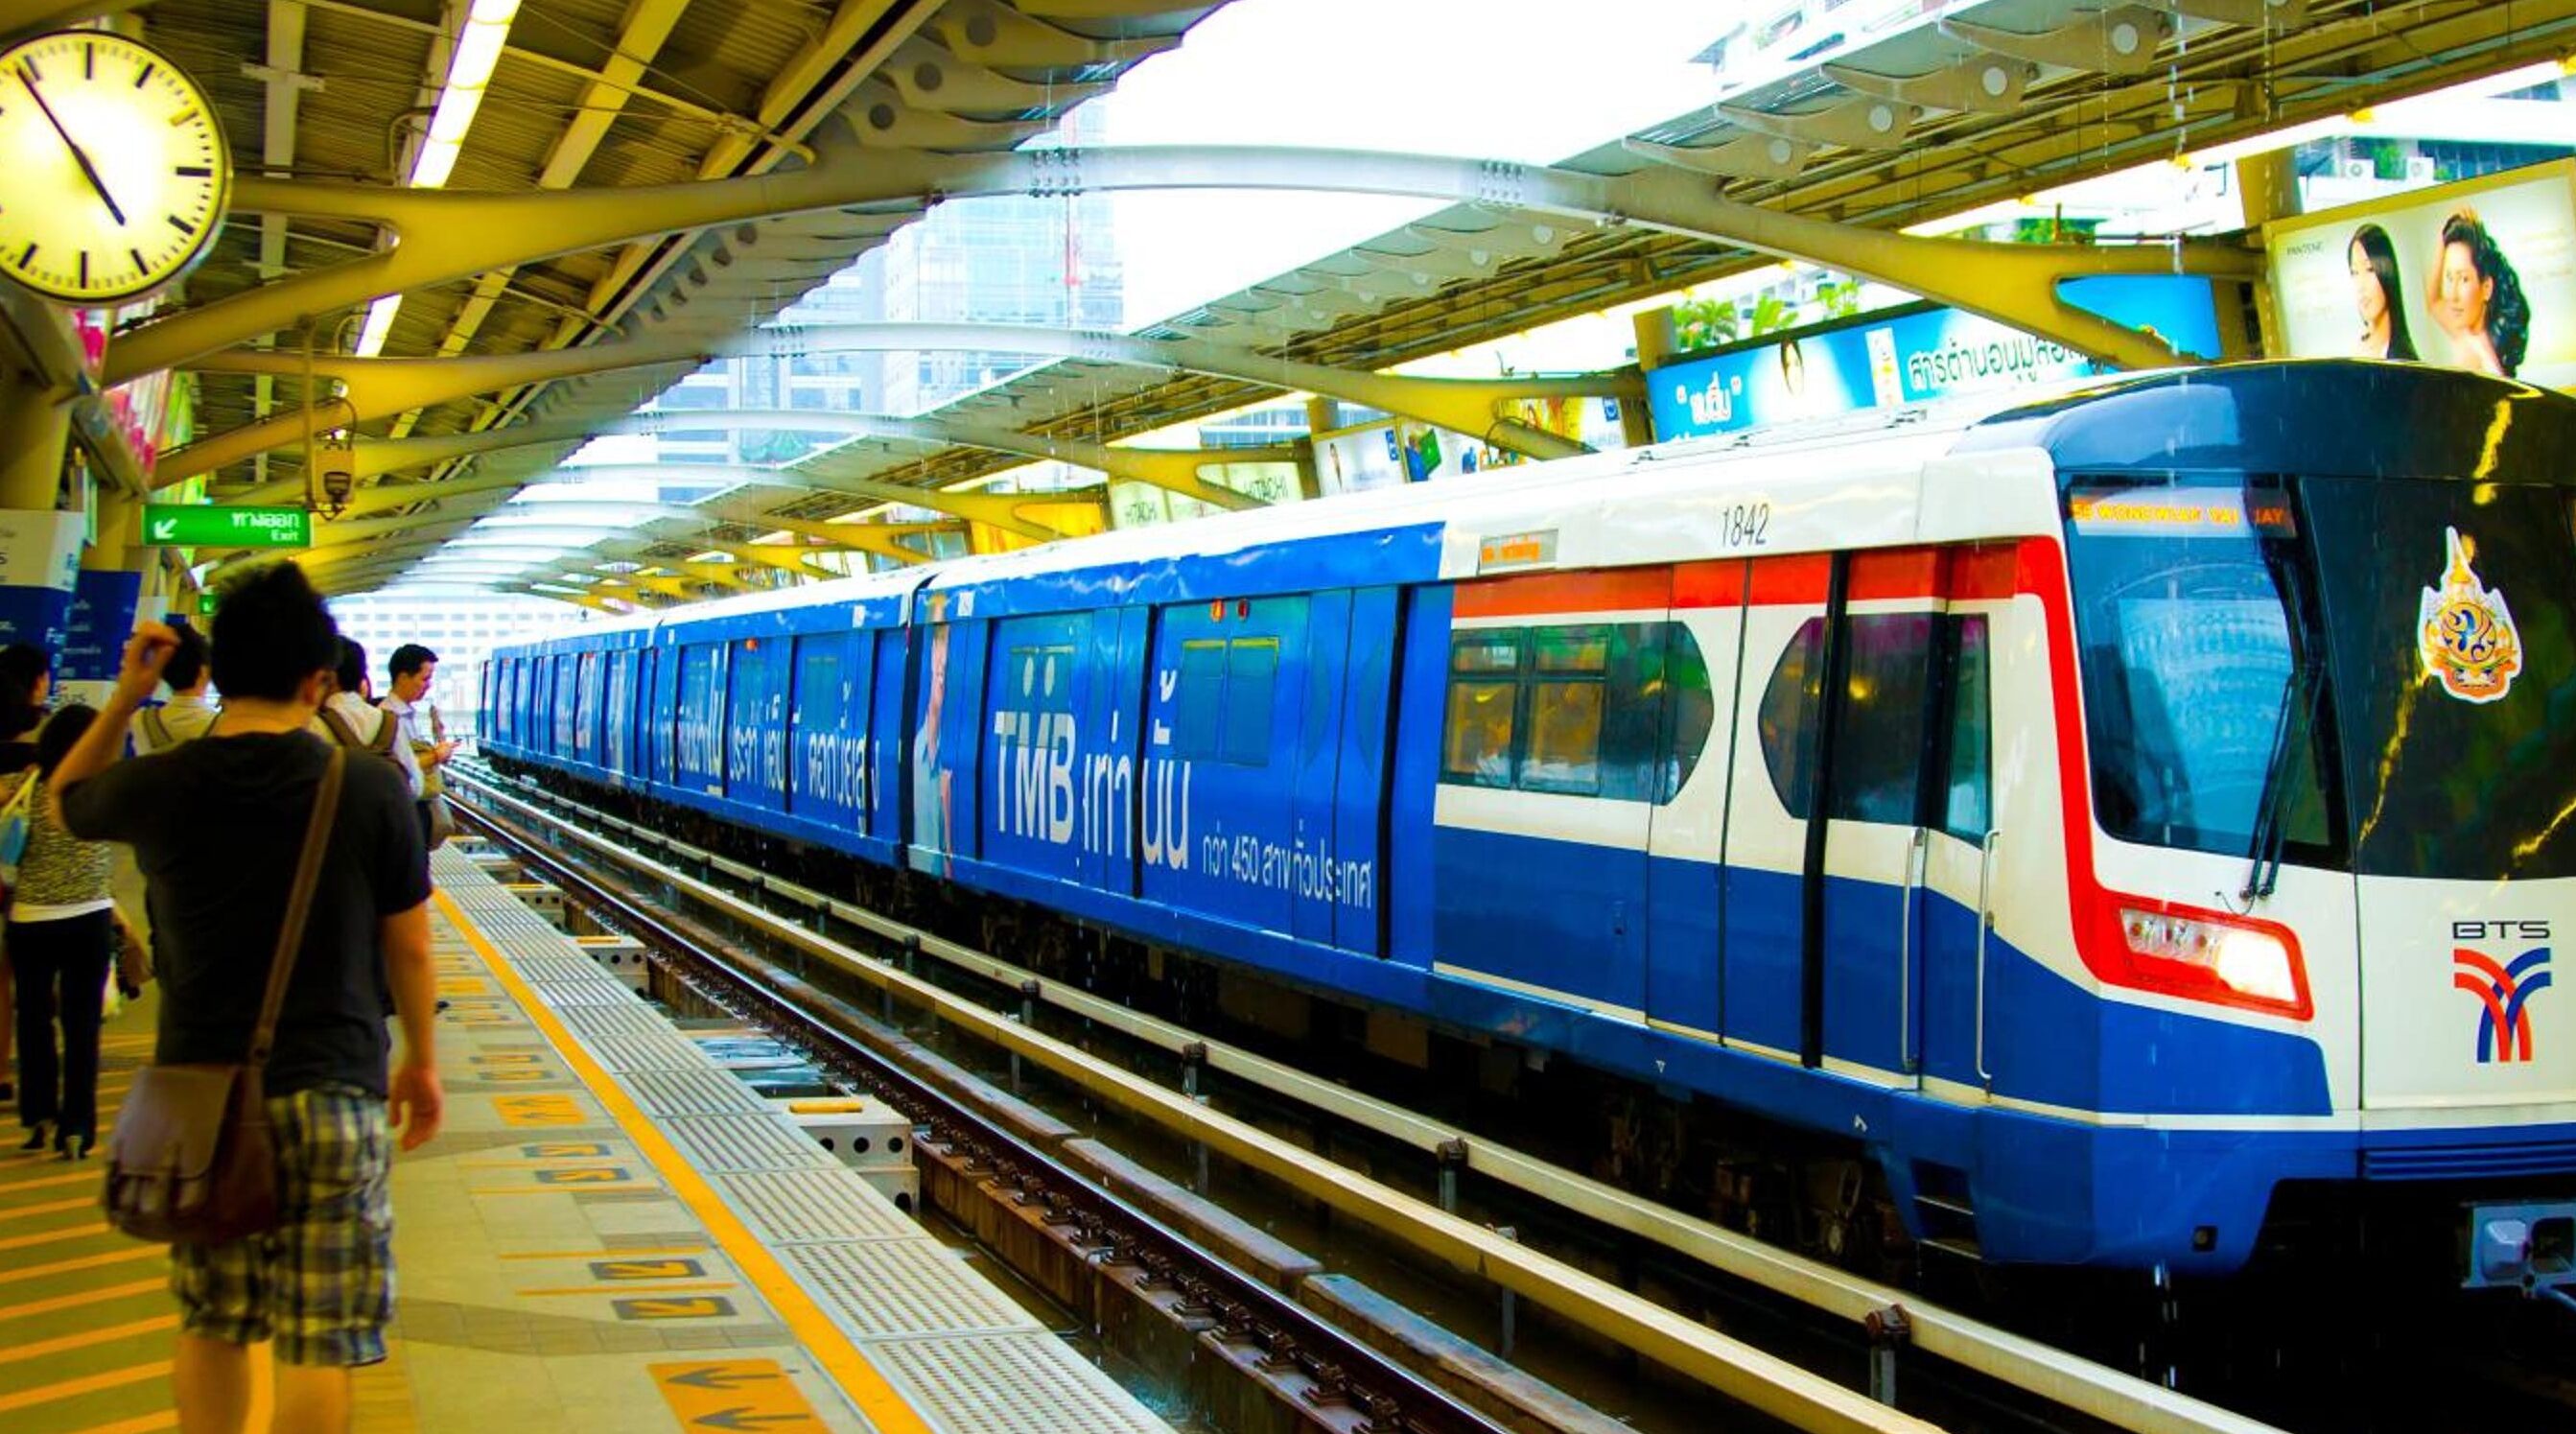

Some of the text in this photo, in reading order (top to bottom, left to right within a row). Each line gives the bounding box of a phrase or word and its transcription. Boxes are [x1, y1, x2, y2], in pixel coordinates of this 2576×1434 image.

[270, 529, 299, 542] Exit
[1721, 511, 1769, 548] 1842
[995, 711, 1076, 844] TMB
[1082, 669, 1191, 870] เท่านั้น
[1203, 819, 1229, 880] กว่า
[1231, 835, 1259, 885] 450
[2451, 921, 2551, 939] BTS
